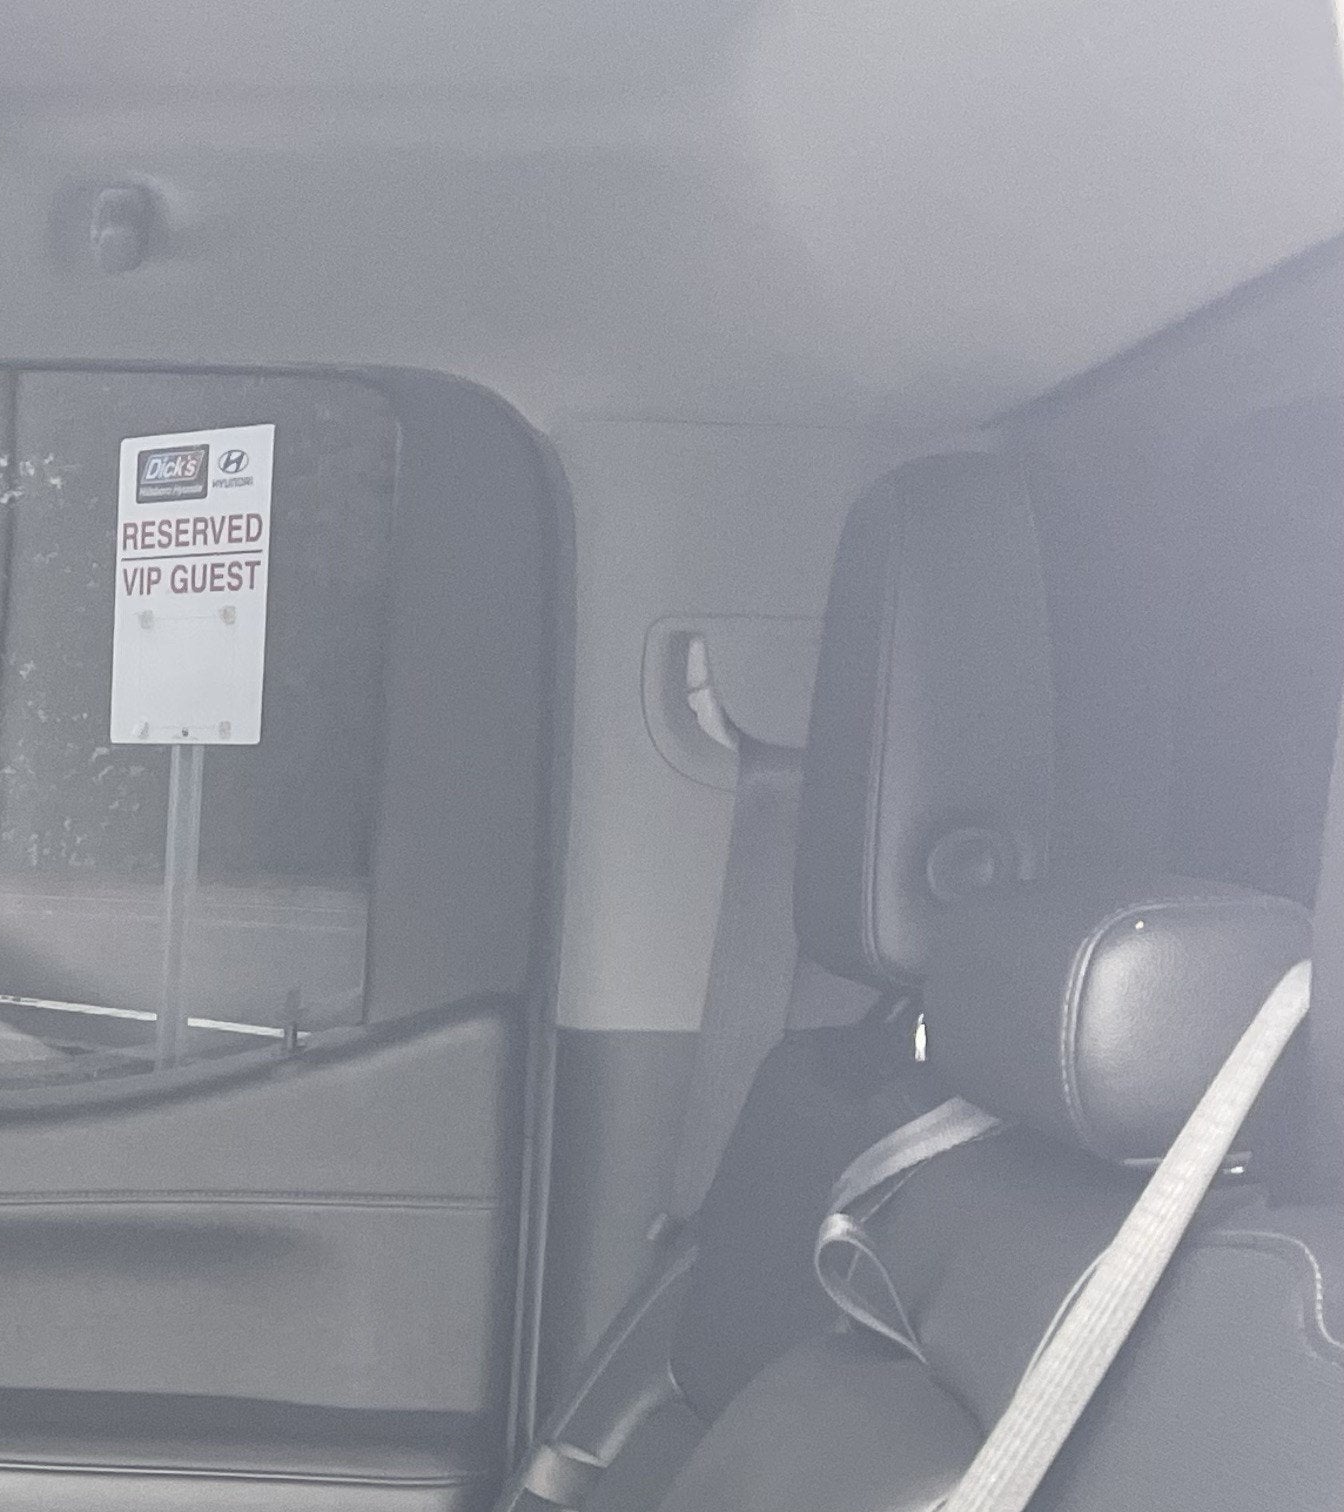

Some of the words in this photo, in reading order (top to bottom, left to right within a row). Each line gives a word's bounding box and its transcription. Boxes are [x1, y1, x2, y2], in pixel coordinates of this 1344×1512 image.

[147, 455, 198, 479] Dick's
[123, 514, 262, 550] RESERVED
[123, 565, 161, 596] VIP
[170, 561, 261, 594] GUEST
